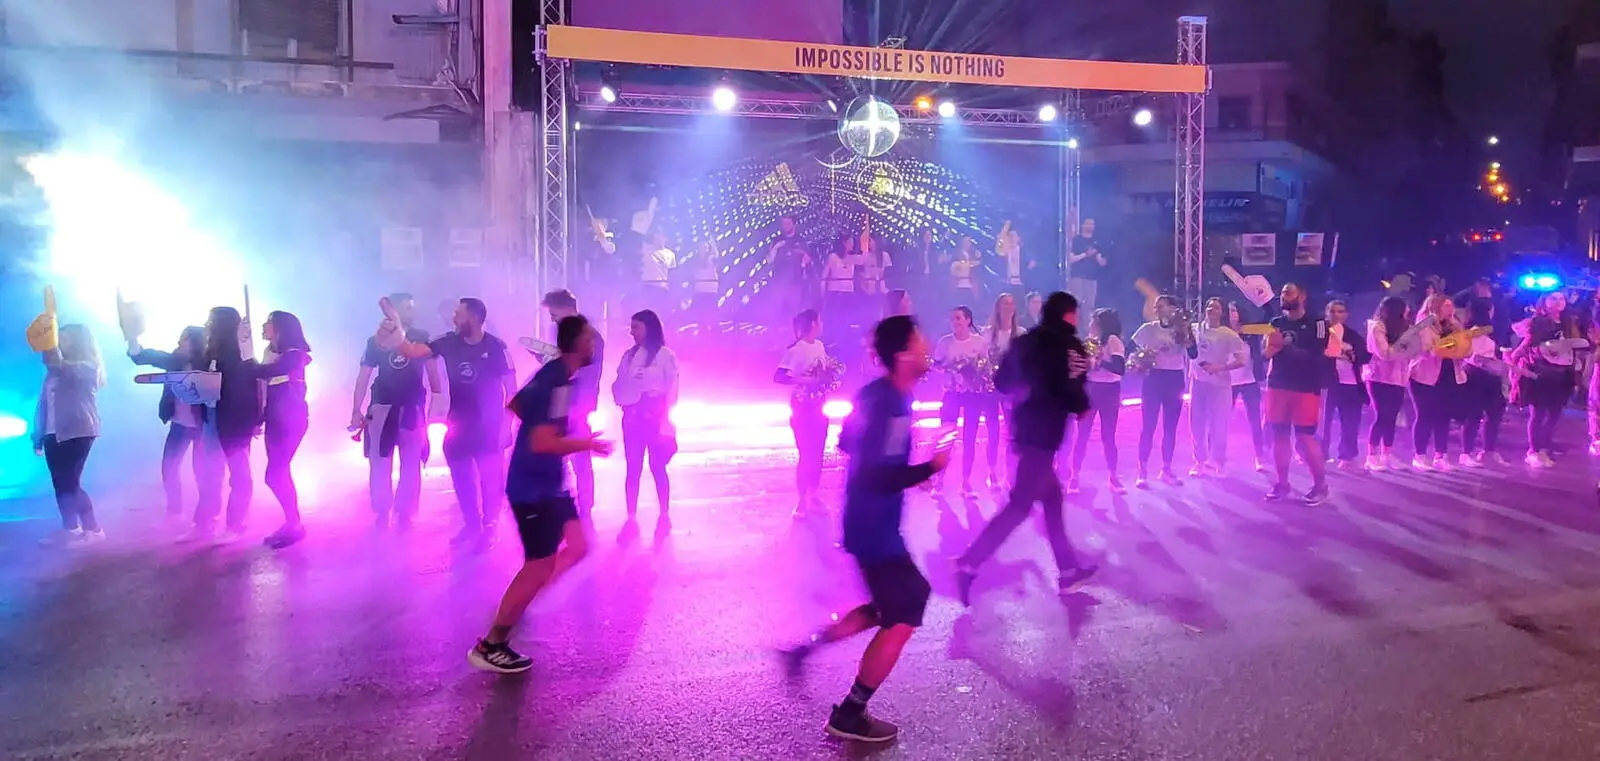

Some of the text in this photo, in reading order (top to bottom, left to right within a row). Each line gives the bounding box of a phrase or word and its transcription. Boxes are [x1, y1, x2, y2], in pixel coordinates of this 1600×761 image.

[795, 47, 1004, 78] IMPOSSIBLE IS NOTHING
